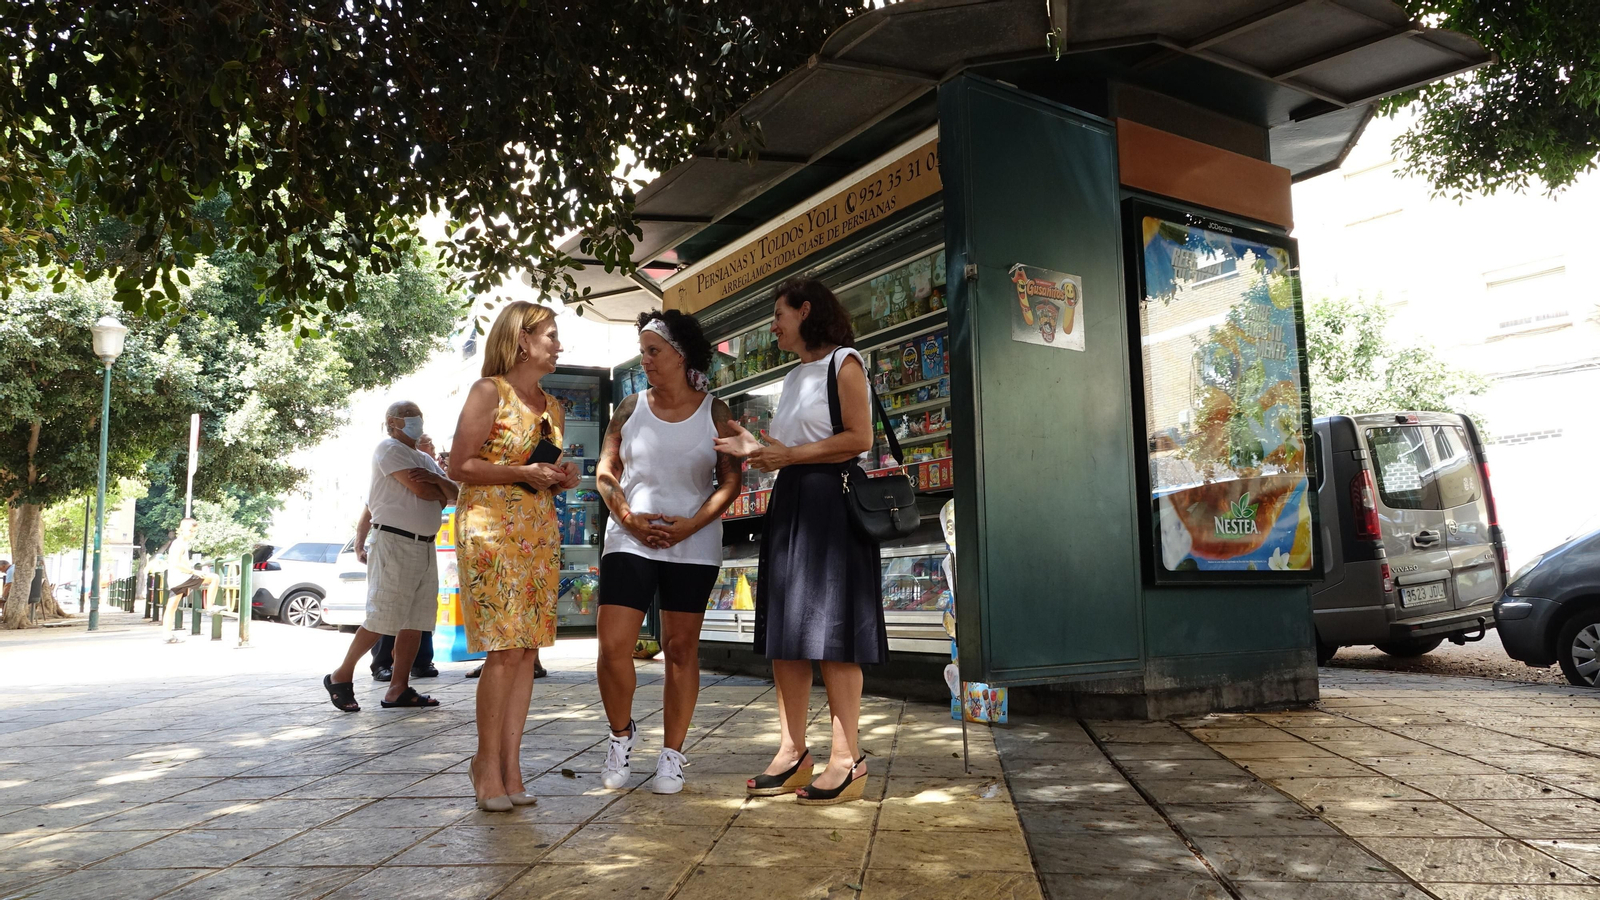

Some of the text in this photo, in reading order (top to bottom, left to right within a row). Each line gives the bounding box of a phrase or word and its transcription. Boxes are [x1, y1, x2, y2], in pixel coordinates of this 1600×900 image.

[697, 253, 748, 294] PERSIANAS
[749, 249, 756, 265] Y
[758, 223, 804, 260] TOLDOS
[806, 204, 838, 234] YOLI
[860, 179, 883, 206] 952
[887, 168, 902, 192] 35
[906, 158, 921, 182] 31
[1208, 222, 1234, 234] JCDecaux
[722, 195, 897, 296] ARREGLAMOS TODA CLASE DE PERSIANAS
[1027, 280, 1065, 301] Gusanitos
[1214, 516, 1259, 535] NESTEA
[1391, 564, 1419, 574] VIVARO
[1406, 587, 1427, 602] 3523
